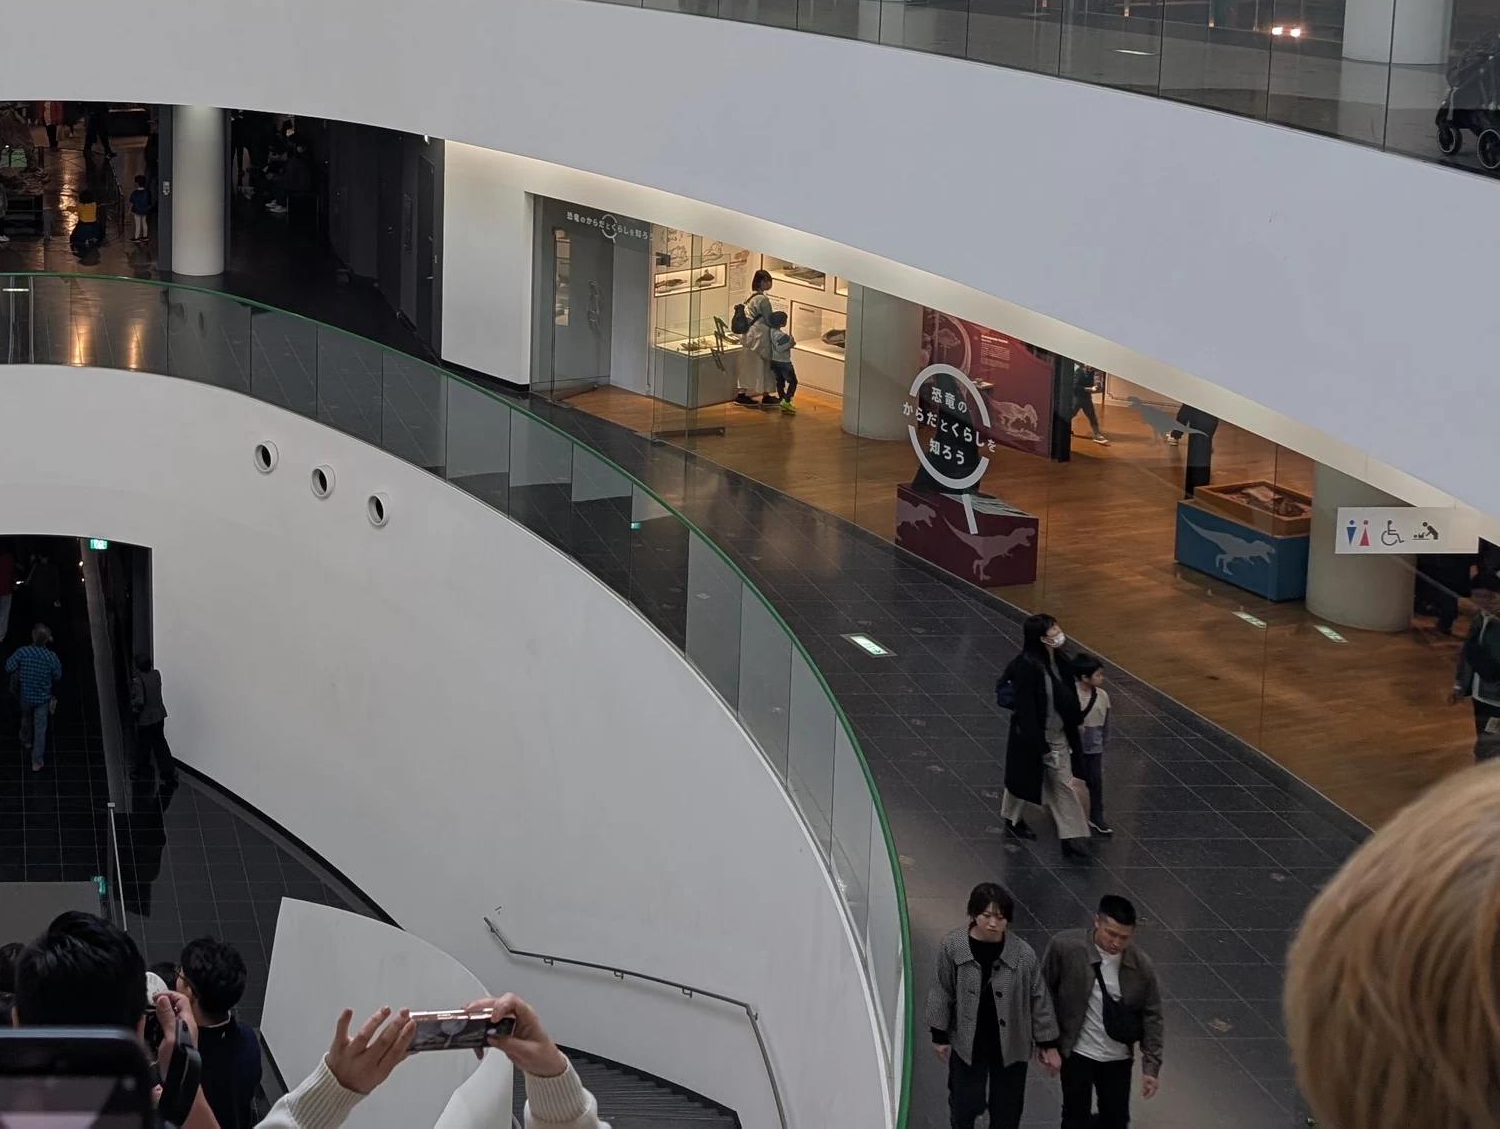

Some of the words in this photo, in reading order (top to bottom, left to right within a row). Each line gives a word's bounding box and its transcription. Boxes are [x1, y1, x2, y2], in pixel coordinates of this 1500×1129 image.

[931, 386, 968, 414] 恐竜の
[902, 401, 997, 453] からだとくらしを
[929, 438, 965, 465] 知ろう
